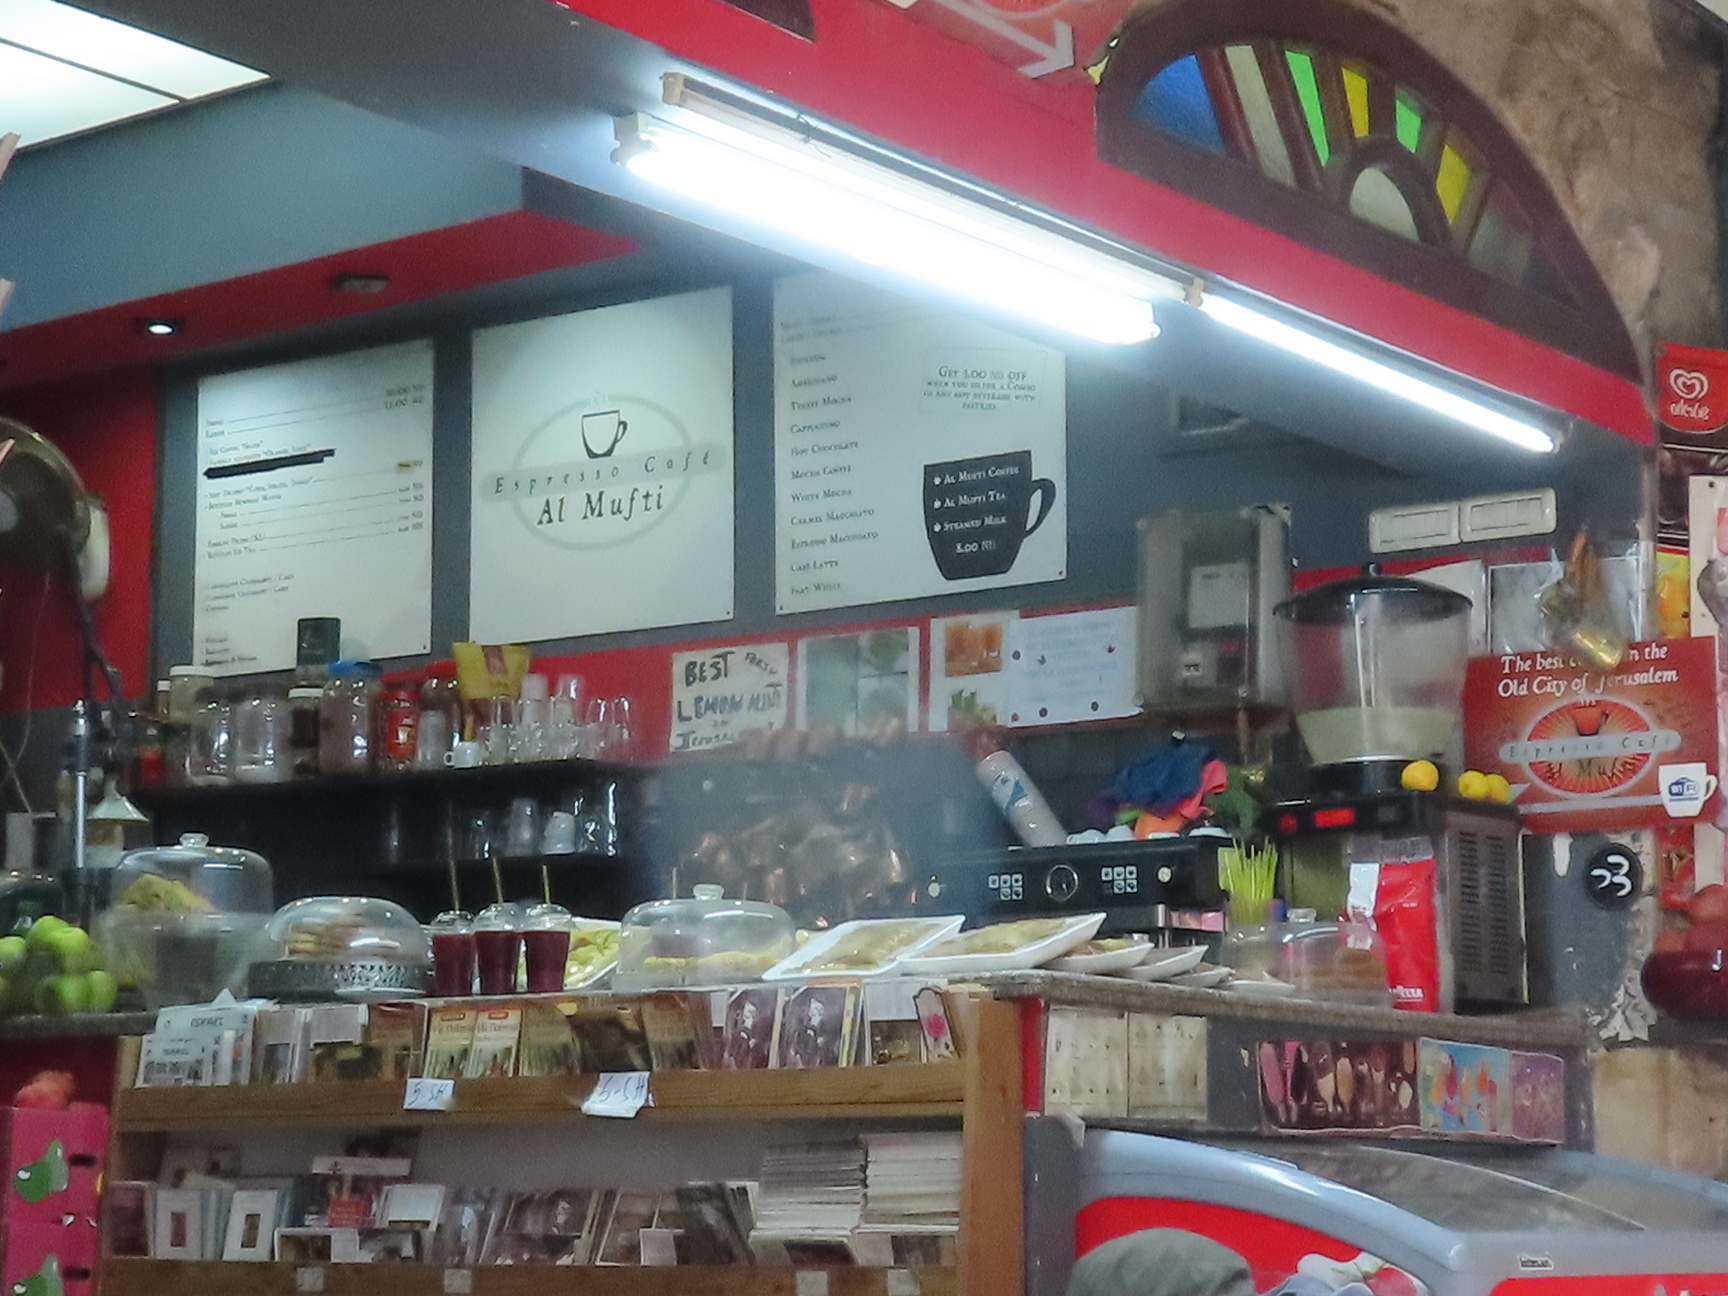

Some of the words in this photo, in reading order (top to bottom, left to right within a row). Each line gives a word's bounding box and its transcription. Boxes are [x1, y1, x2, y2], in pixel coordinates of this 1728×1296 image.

[494, 465, 620, 495] Espresso
[644, 450, 710, 473] Café
[536, 496, 566, 526] Al
[581, 484, 664, 522] Mufti
[685, 650, 736, 688] BEST
[1501, 654, 1531, 674] The
[1536, 655, 1564, 671] best
[1644, 642, 1669, 660] the
[1498, 678, 1529, 698] Old
[1532, 675, 1568, 697] City
[1571, 671, 1590, 694] of
[677, 693, 744, 722] LEMON
